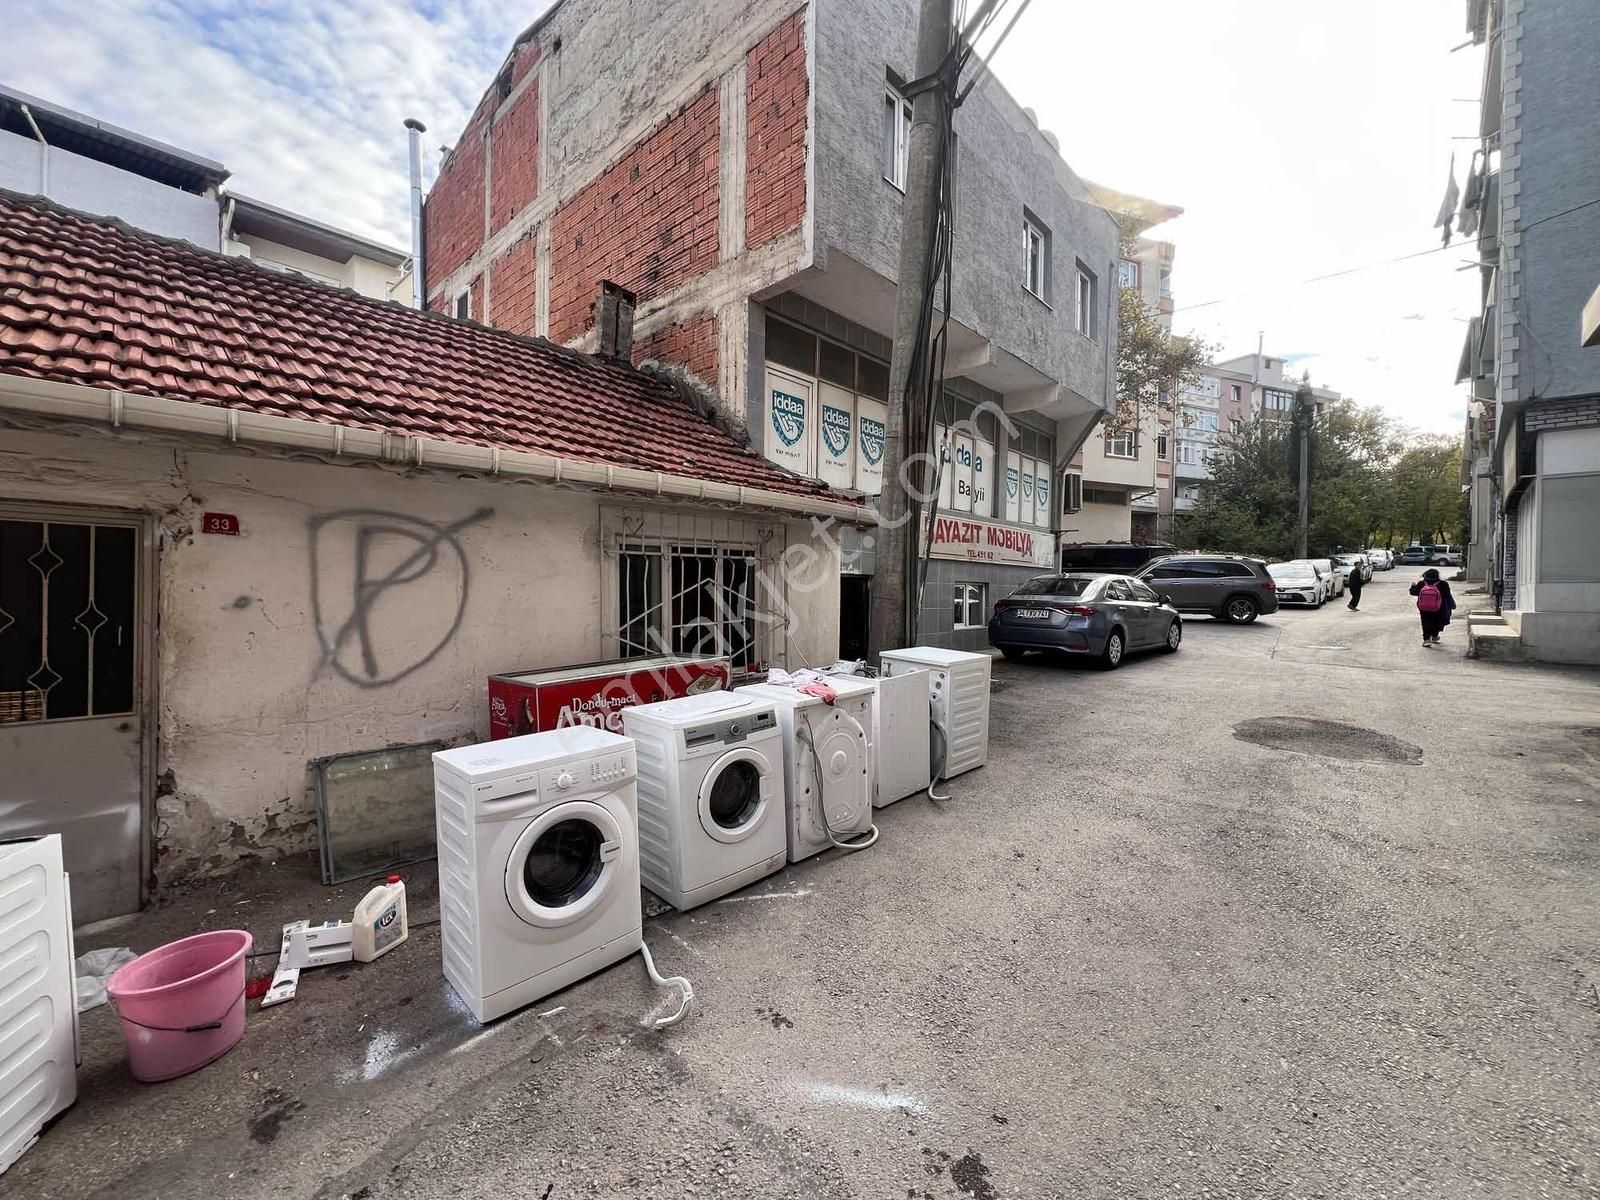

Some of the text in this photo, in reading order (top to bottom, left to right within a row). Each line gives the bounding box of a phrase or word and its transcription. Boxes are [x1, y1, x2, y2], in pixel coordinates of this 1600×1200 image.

[774, 392, 803, 416] iddaa
[823, 406, 849, 428] iddaa
[861, 418, 884, 437] iddaa
[958, 480, 985, 503] Bayii
[211, 518, 230, 530] 33
[556, 705, 625, 731] Amc
